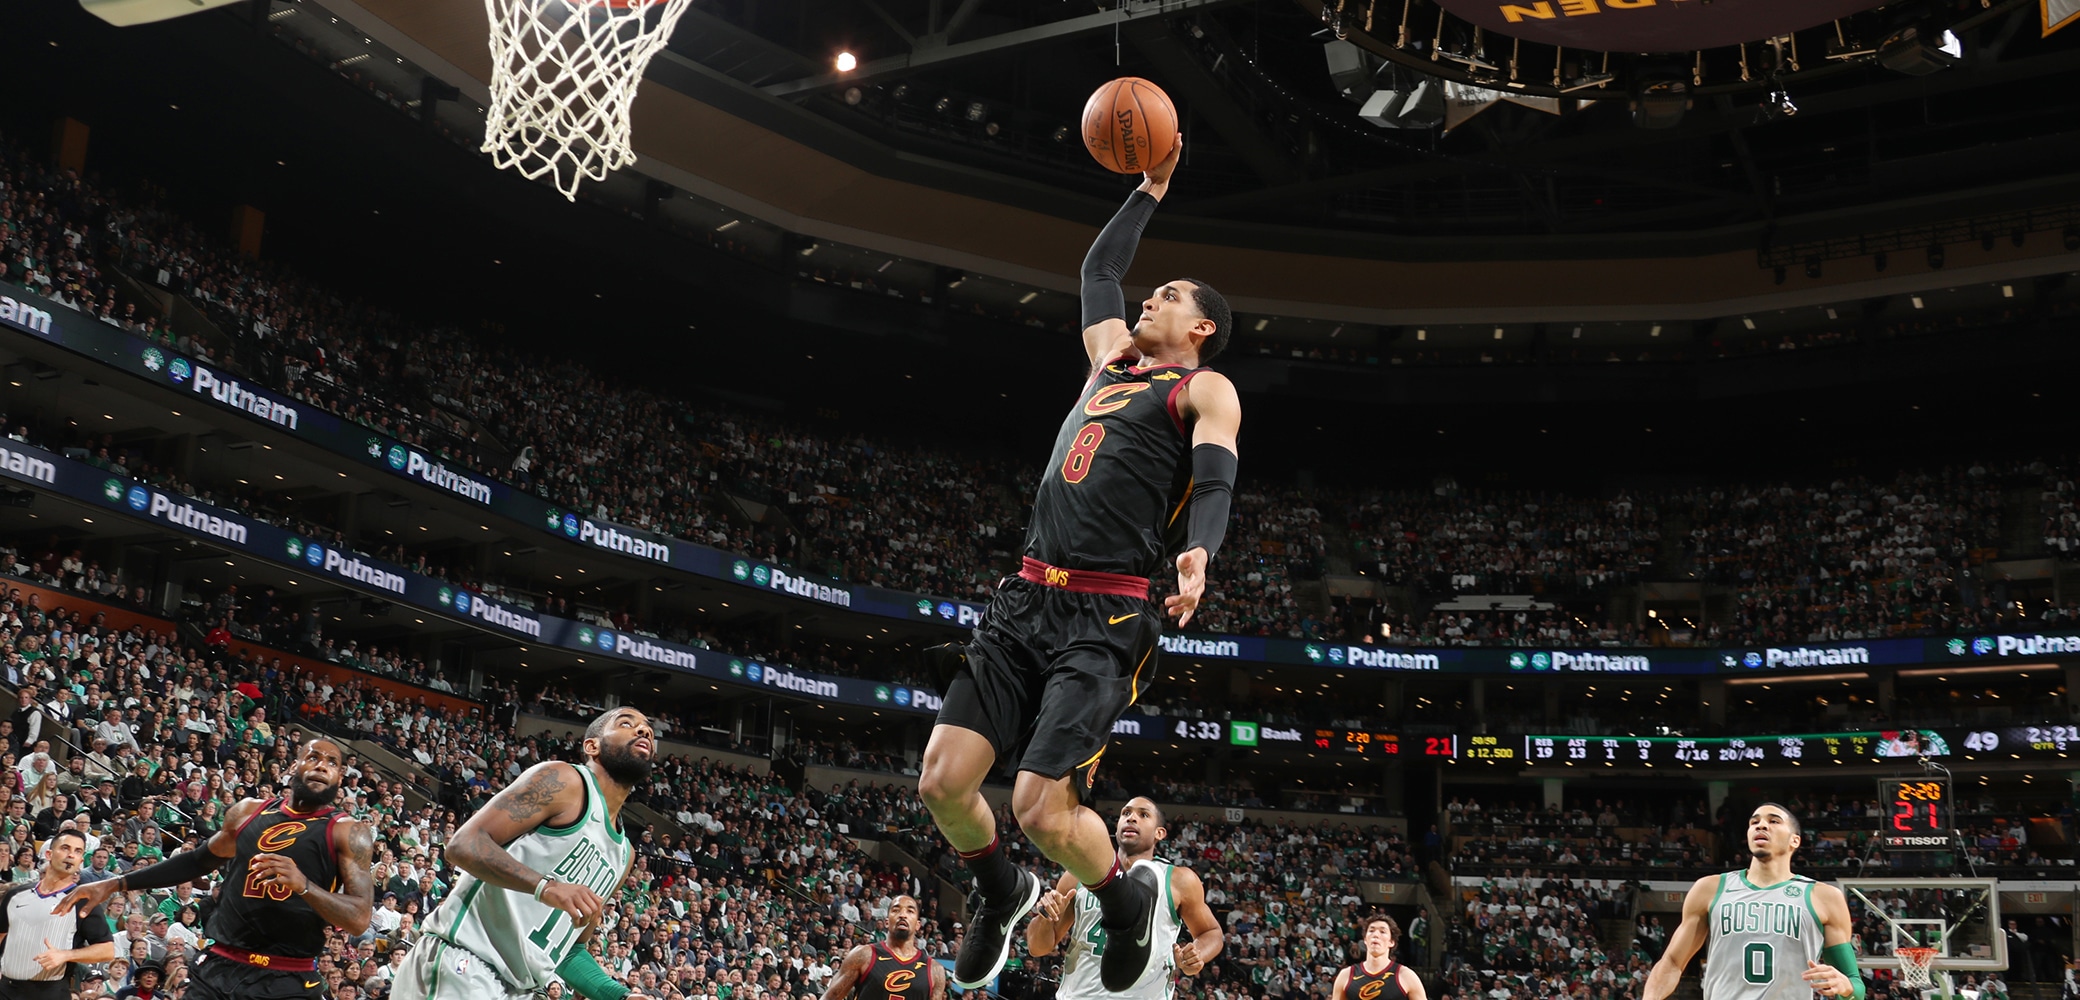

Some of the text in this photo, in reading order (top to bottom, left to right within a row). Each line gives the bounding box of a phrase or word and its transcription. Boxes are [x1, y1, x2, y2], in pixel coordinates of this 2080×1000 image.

[1117, 109, 1140, 171] SPALDING
[193, 365, 298, 430] Putnam
[1061, 422, 1105, 484] 8
[407, 451, 491, 505] Putnam
[150, 493, 247, 544] Putnam
[580, 518, 669, 563] Putnam
[325, 550, 406, 594] Putnam
[1045, 567, 1069, 586] CAVS
[770, 568, 850, 607] Putnam
[470, 599, 541, 637] Putnam
[615, 632, 696, 670] Putnam
[1348, 646, 1439, 670] Putnam
[1551, 651, 1650, 672] Putnam
[1766, 647, 1868, 668] Putnam
[763, 666, 839, 698] Putnam
[1175, 720, 1221, 741] 4:33
[1261, 727, 1302, 742] Bank
[2026, 725, 2080, 743] 2:21
[1425, 737, 1453, 756] 21
[1535, 739, 1554, 747] REB
[1568, 739, 1587, 747] AST
[1603, 739, 1619, 748] STL
[1636, 740, 1651, 748] TO
[1677, 740, 1696, 749] 3PT
[1963, 731, 1999, 752] 49
[1536, 747, 1553, 758] 19
[1569, 747, 1587, 758] 13
[1606, 748, 1615, 759] 1
[1639, 749, 1649, 759] 3
[1674, 750, 1710, 761] 4/16
[1719, 748, 1764, 761] 20/44
[1781, 747, 1802, 758] 45
[1228, 810, 1241, 820] 16
[1893, 801, 1938, 831] 21
[1903, 836, 1949, 846] TISSOT
[551, 836, 618, 898] BOSTO
[1720, 901, 1803, 941] BOSTON
[250, 954, 270, 966] CAVS
[1743, 941, 1775, 985] 0
